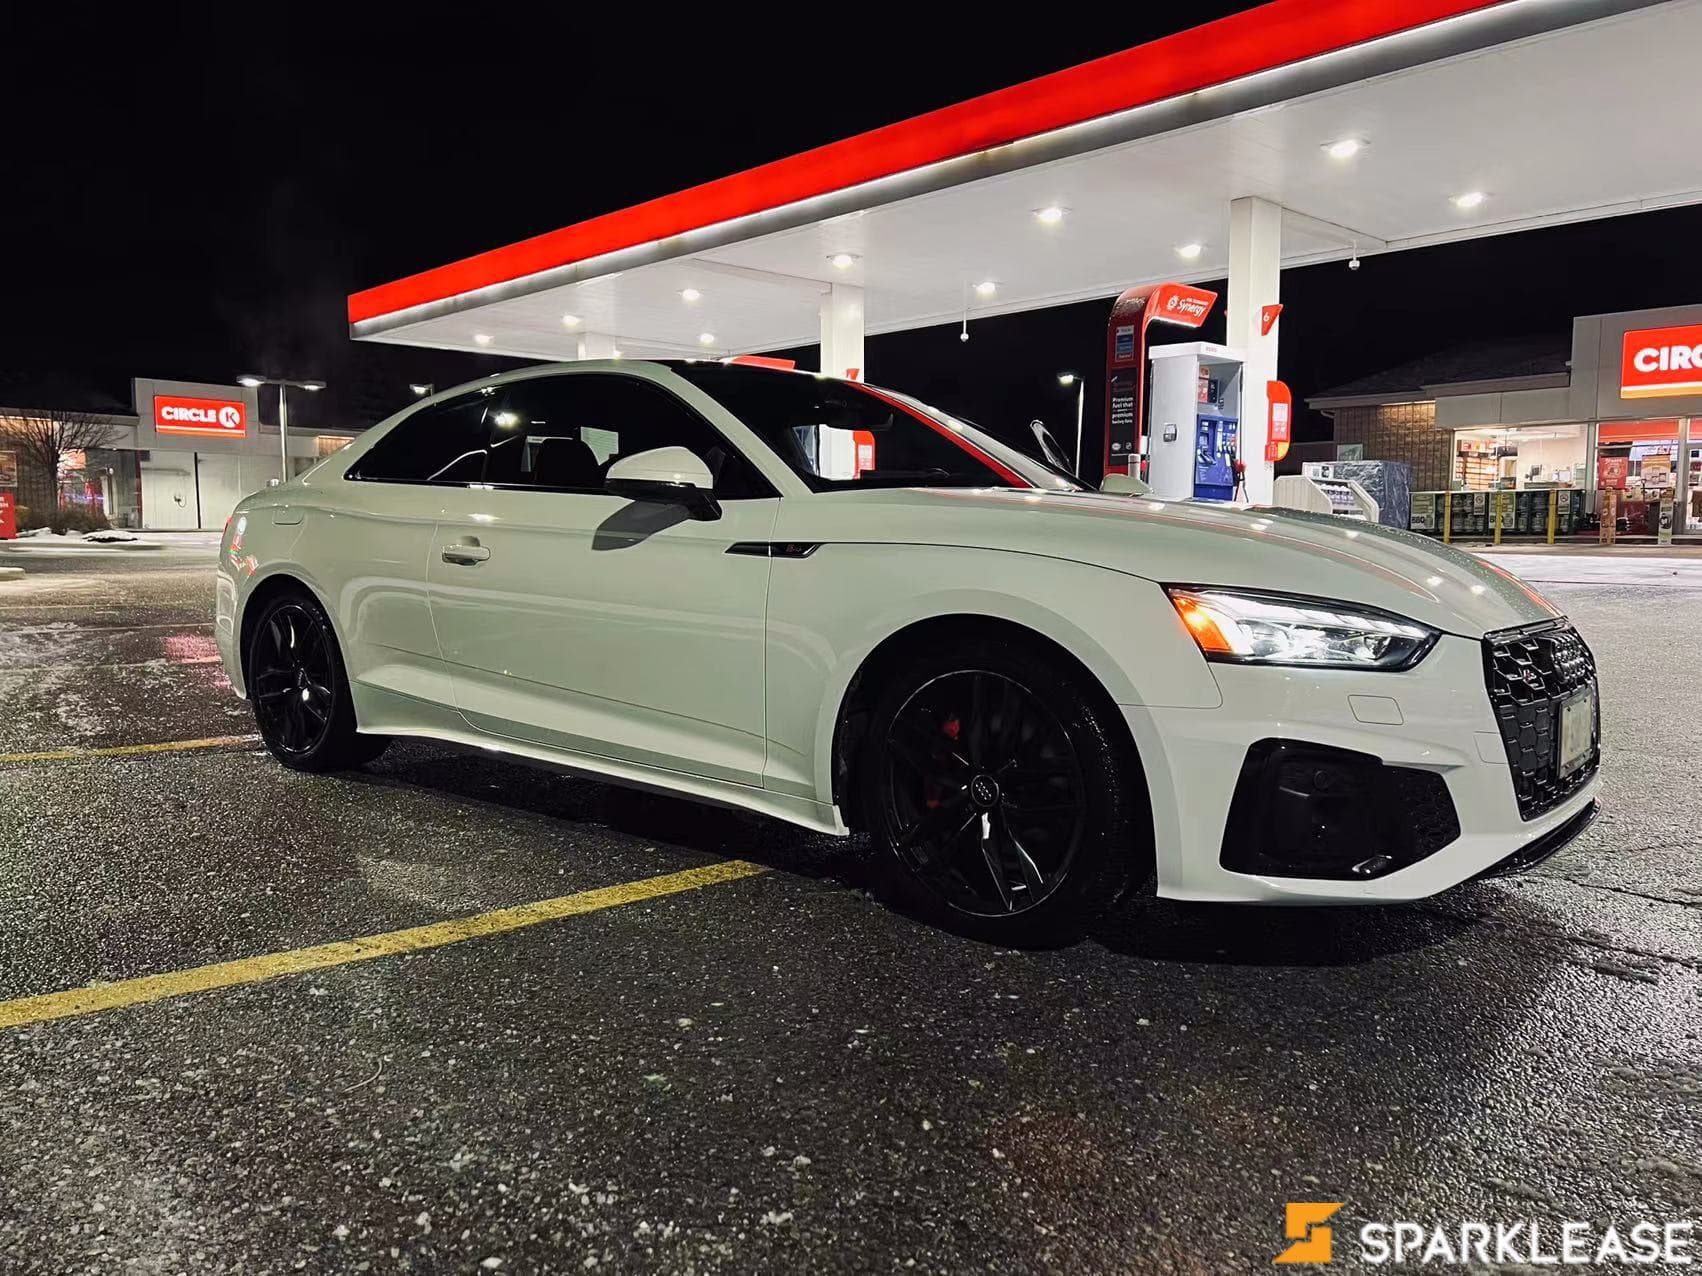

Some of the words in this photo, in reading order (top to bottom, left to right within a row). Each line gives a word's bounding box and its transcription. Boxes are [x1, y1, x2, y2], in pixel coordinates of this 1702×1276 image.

[1177, 299, 1206, 317] Synergy
[1263, 311, 1270, 322] 6
[162, 406, 216, 422] CIRCLE
